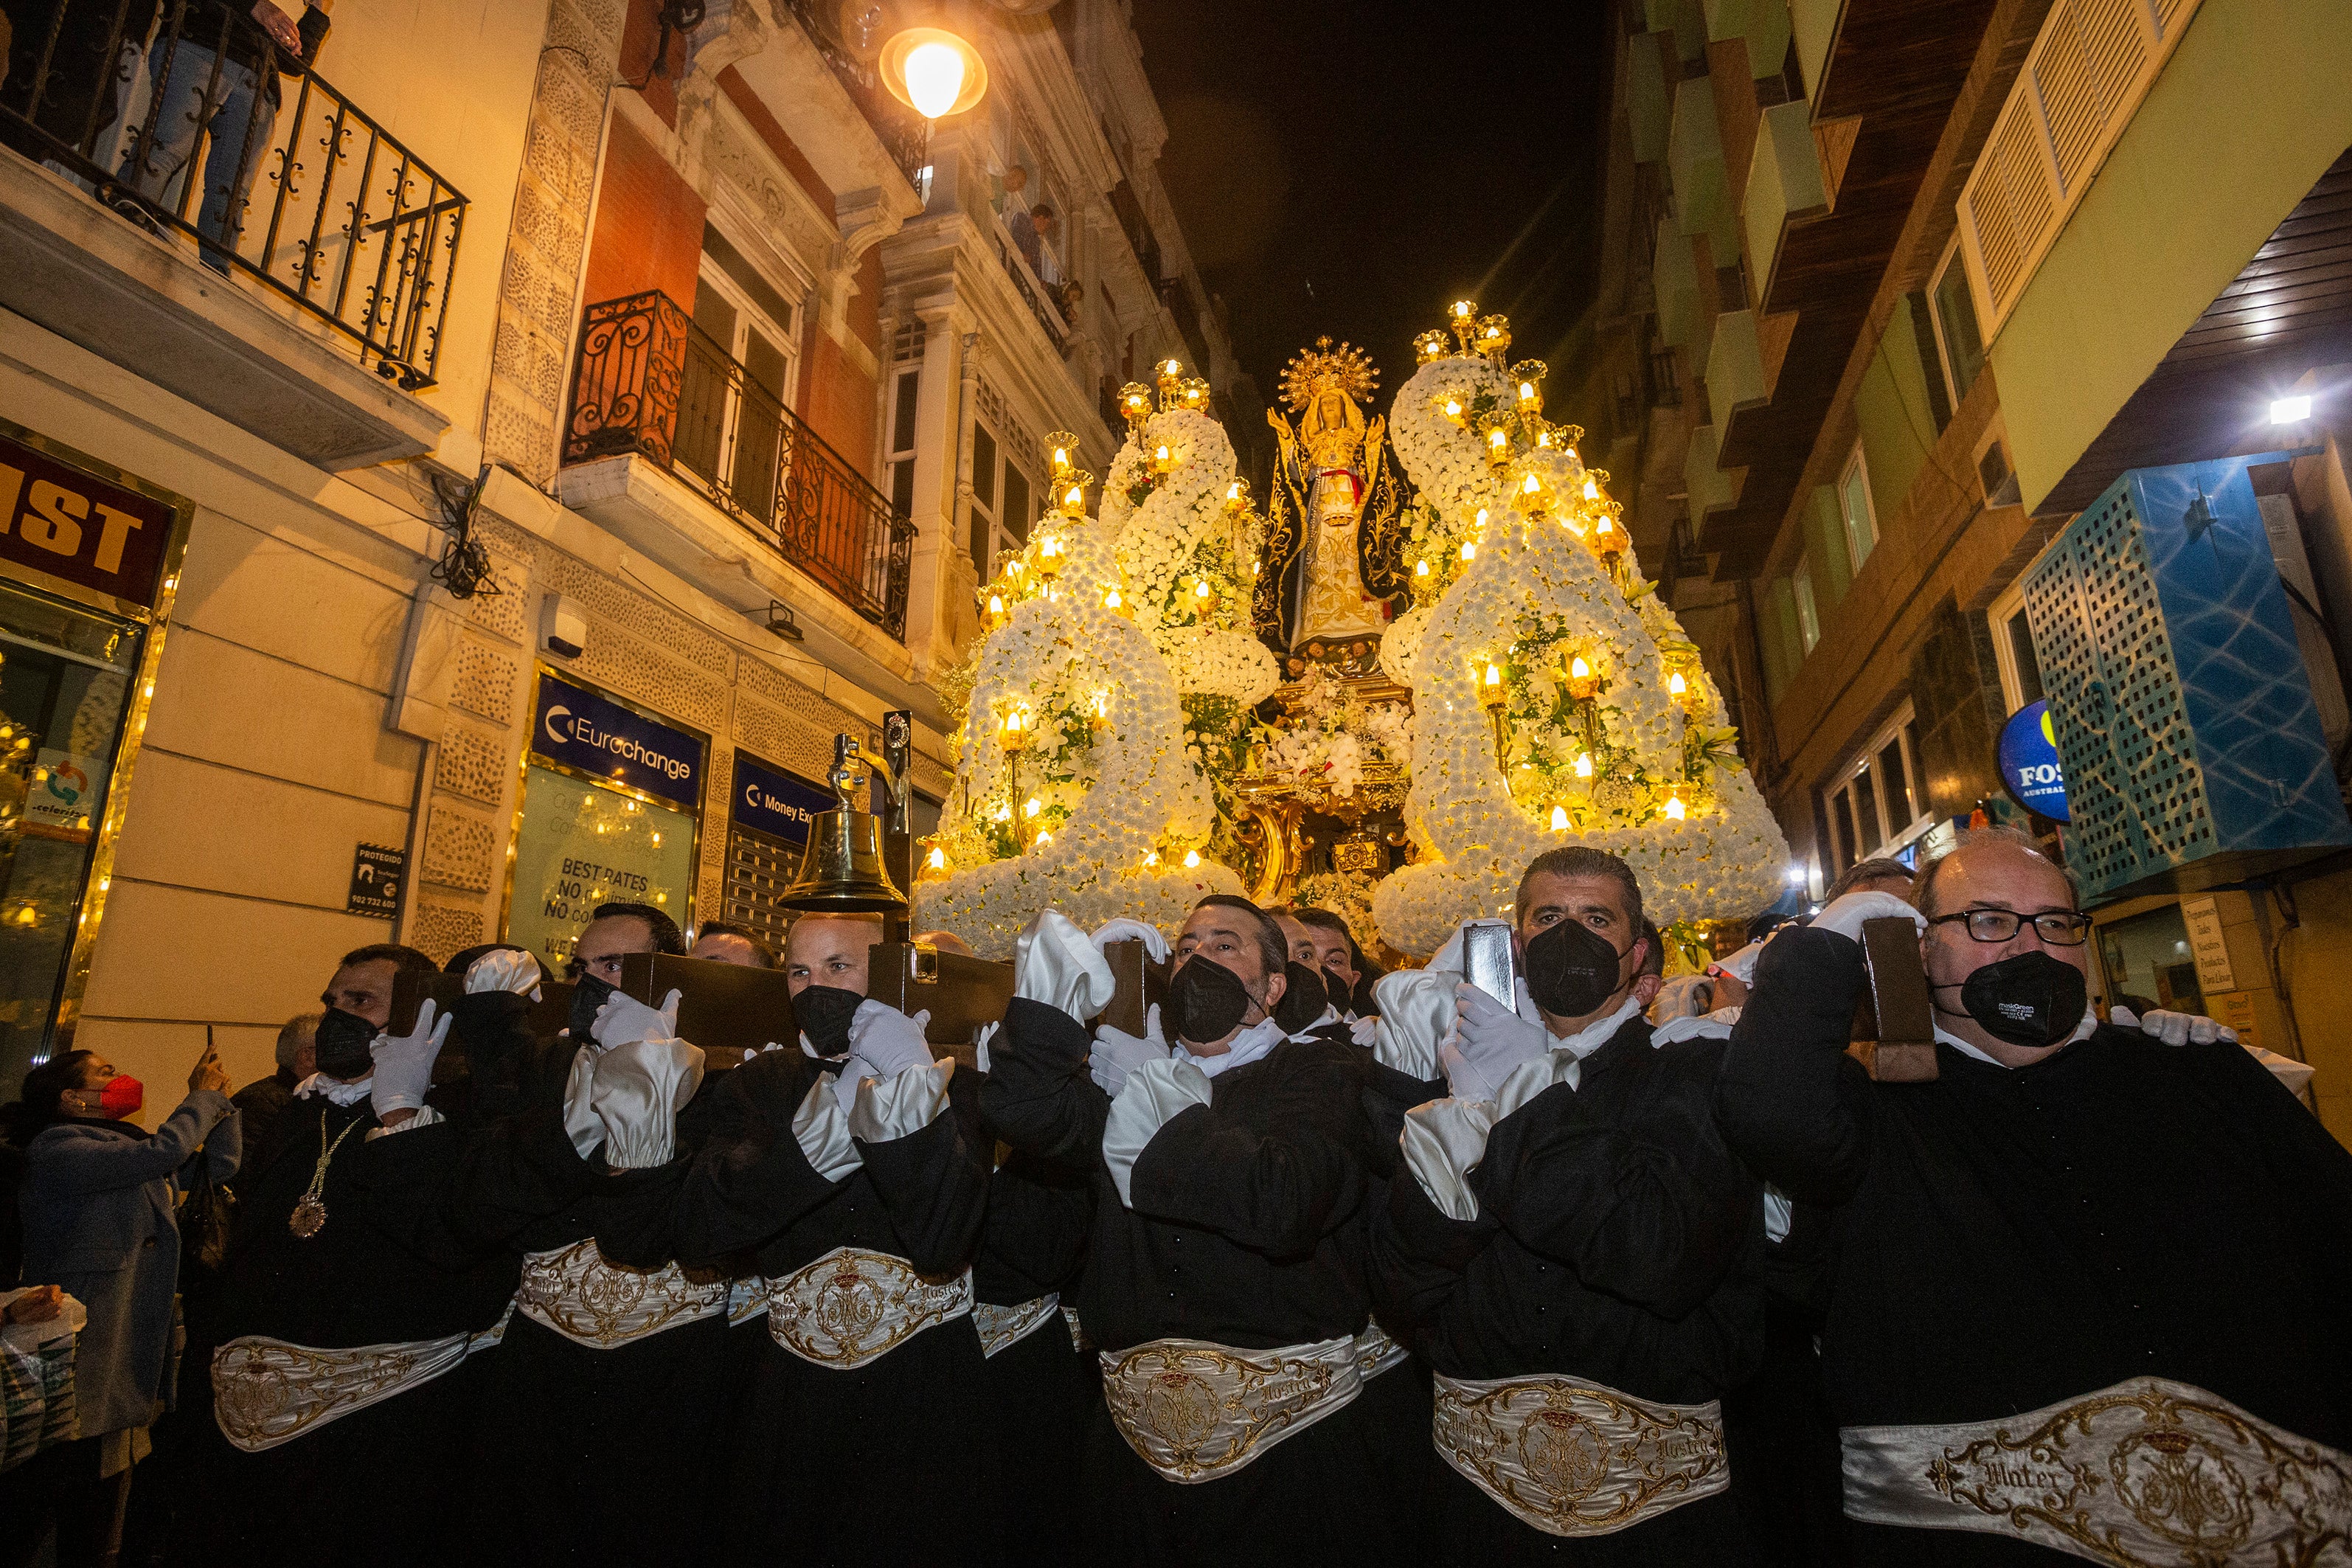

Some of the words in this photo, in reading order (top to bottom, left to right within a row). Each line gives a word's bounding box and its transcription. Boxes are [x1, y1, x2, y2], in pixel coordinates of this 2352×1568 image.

[575, 717, 691, 780] Eurochange
[765, 794, 797, 822] Money
[359, 850, 403, 864] PROTEGIDO
[562, 858, 602, 881] BEST
[603, 870, 648, 892] RATES
[558, 879, 580, 899] NO
[352, 895, 366, 904] 902
[367, 898, 381, 906] 732
[382, 901, 396, 909] 600
[544, 900, 568, 919] NO
